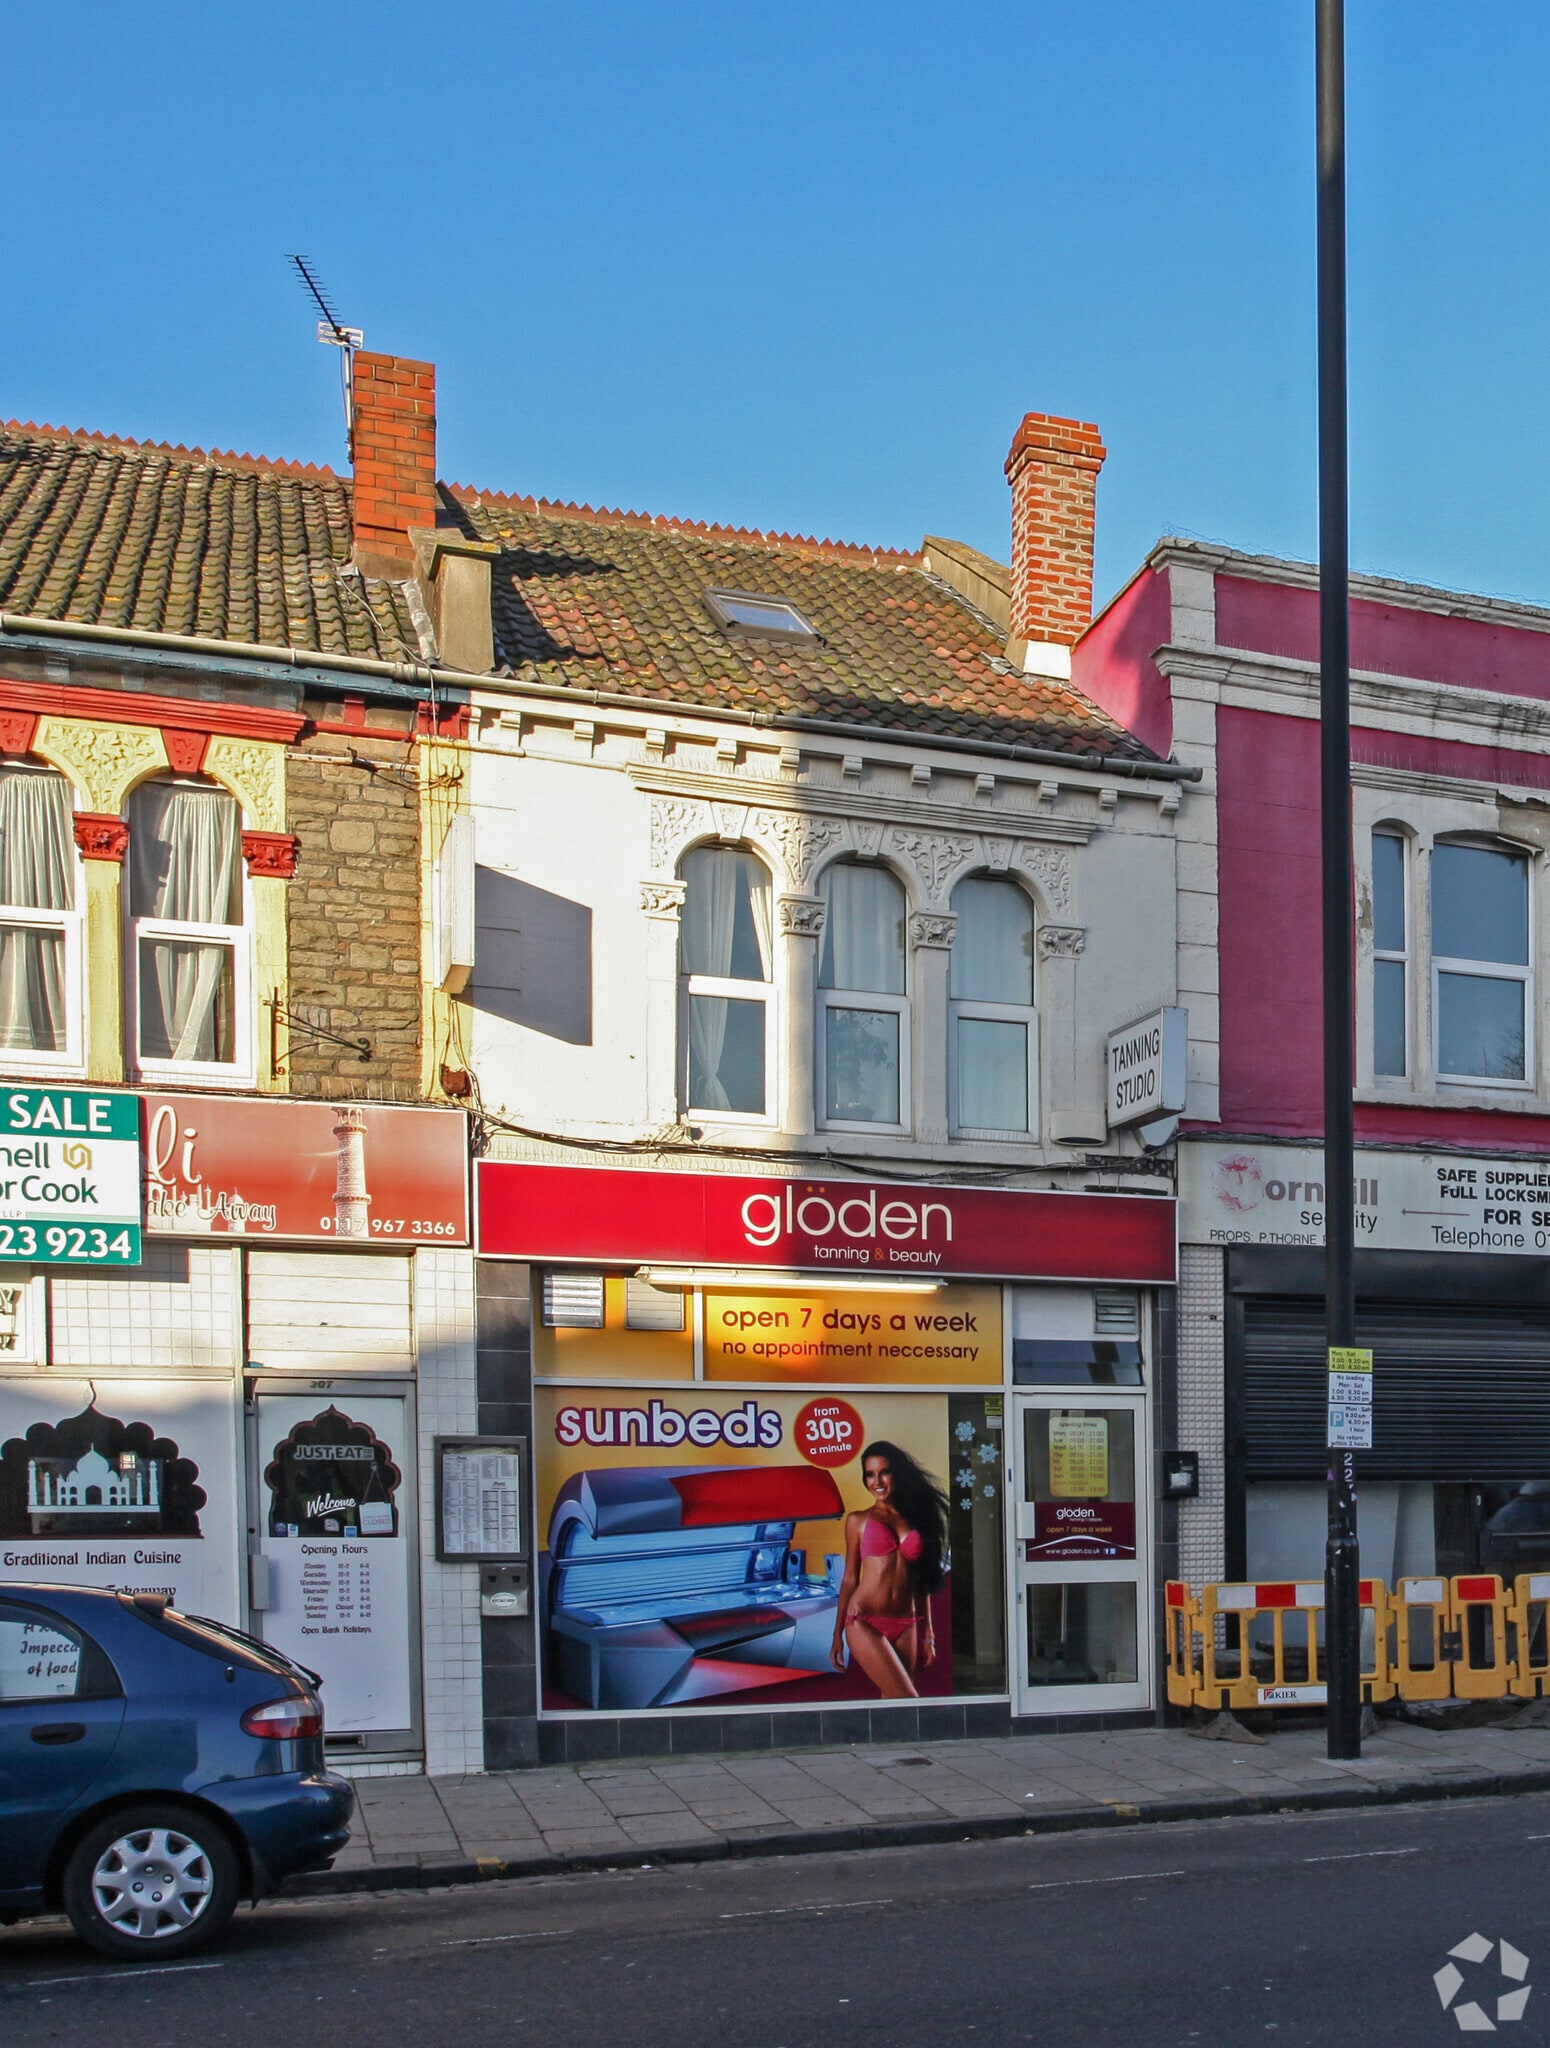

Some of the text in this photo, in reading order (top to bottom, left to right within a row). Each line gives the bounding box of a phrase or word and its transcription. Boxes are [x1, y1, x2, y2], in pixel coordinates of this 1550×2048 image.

[1112, 1028, 1160, 1073] TANNING
[1116, 1069, 1155, 1109] STUDIO
[9, 1094, 112, 1132] SALE
[1437, 1168, 1550, 1187] SAFE SUPPLIE
[21, 1175, 98, 1204] Cook
[1441, 1185, 1477, 1199] FULL
[3, 1210, 22, 1218] LLP
[197, 1191, 278, 1231] Away
[1484, 1209, 1521, 1225] FOR
[371, 1219, 405, 1233] 967
[411, 1220, 456, 1235] 3366
[1300, 1211, 1378, 1233] seity
[45, 1227, 132, 1259] 9234
[1210, 1230, 1253, 1243] PROPS:
[1431, 1226, 1525, 1249] Telephone
[814, 1245, 941, 1265] tanning & beauty
[722, 1308, 977, 1334] open 7 days a week
[723, 1340, 978, 1362] no appointment neccessary
[813, 1406, 839, 1417] from
[1333, 1412, 1343, 1427] P
[556, 1400, 782, 1447] sunbeds
[805, 1418, 852, 1443] 30p
[294, 1446, 332, 1459] JUST
[336, 1446, 363, 1459] EAT
[810, 1442, 852, 1455] a minute
[307, 1493, 356, 1518] Welcome
[3, 1550, 182, 1566] Traditional Indian Cuisine
[301, 1544, 368, 1556] Opening Hours
[301, 1626, 319, 1636] Open
[343, 1626, 372, 1636] Holidays
[28, 1661, 77, 1677] of food
[1275, 1691, 1296, 1699] KIER
